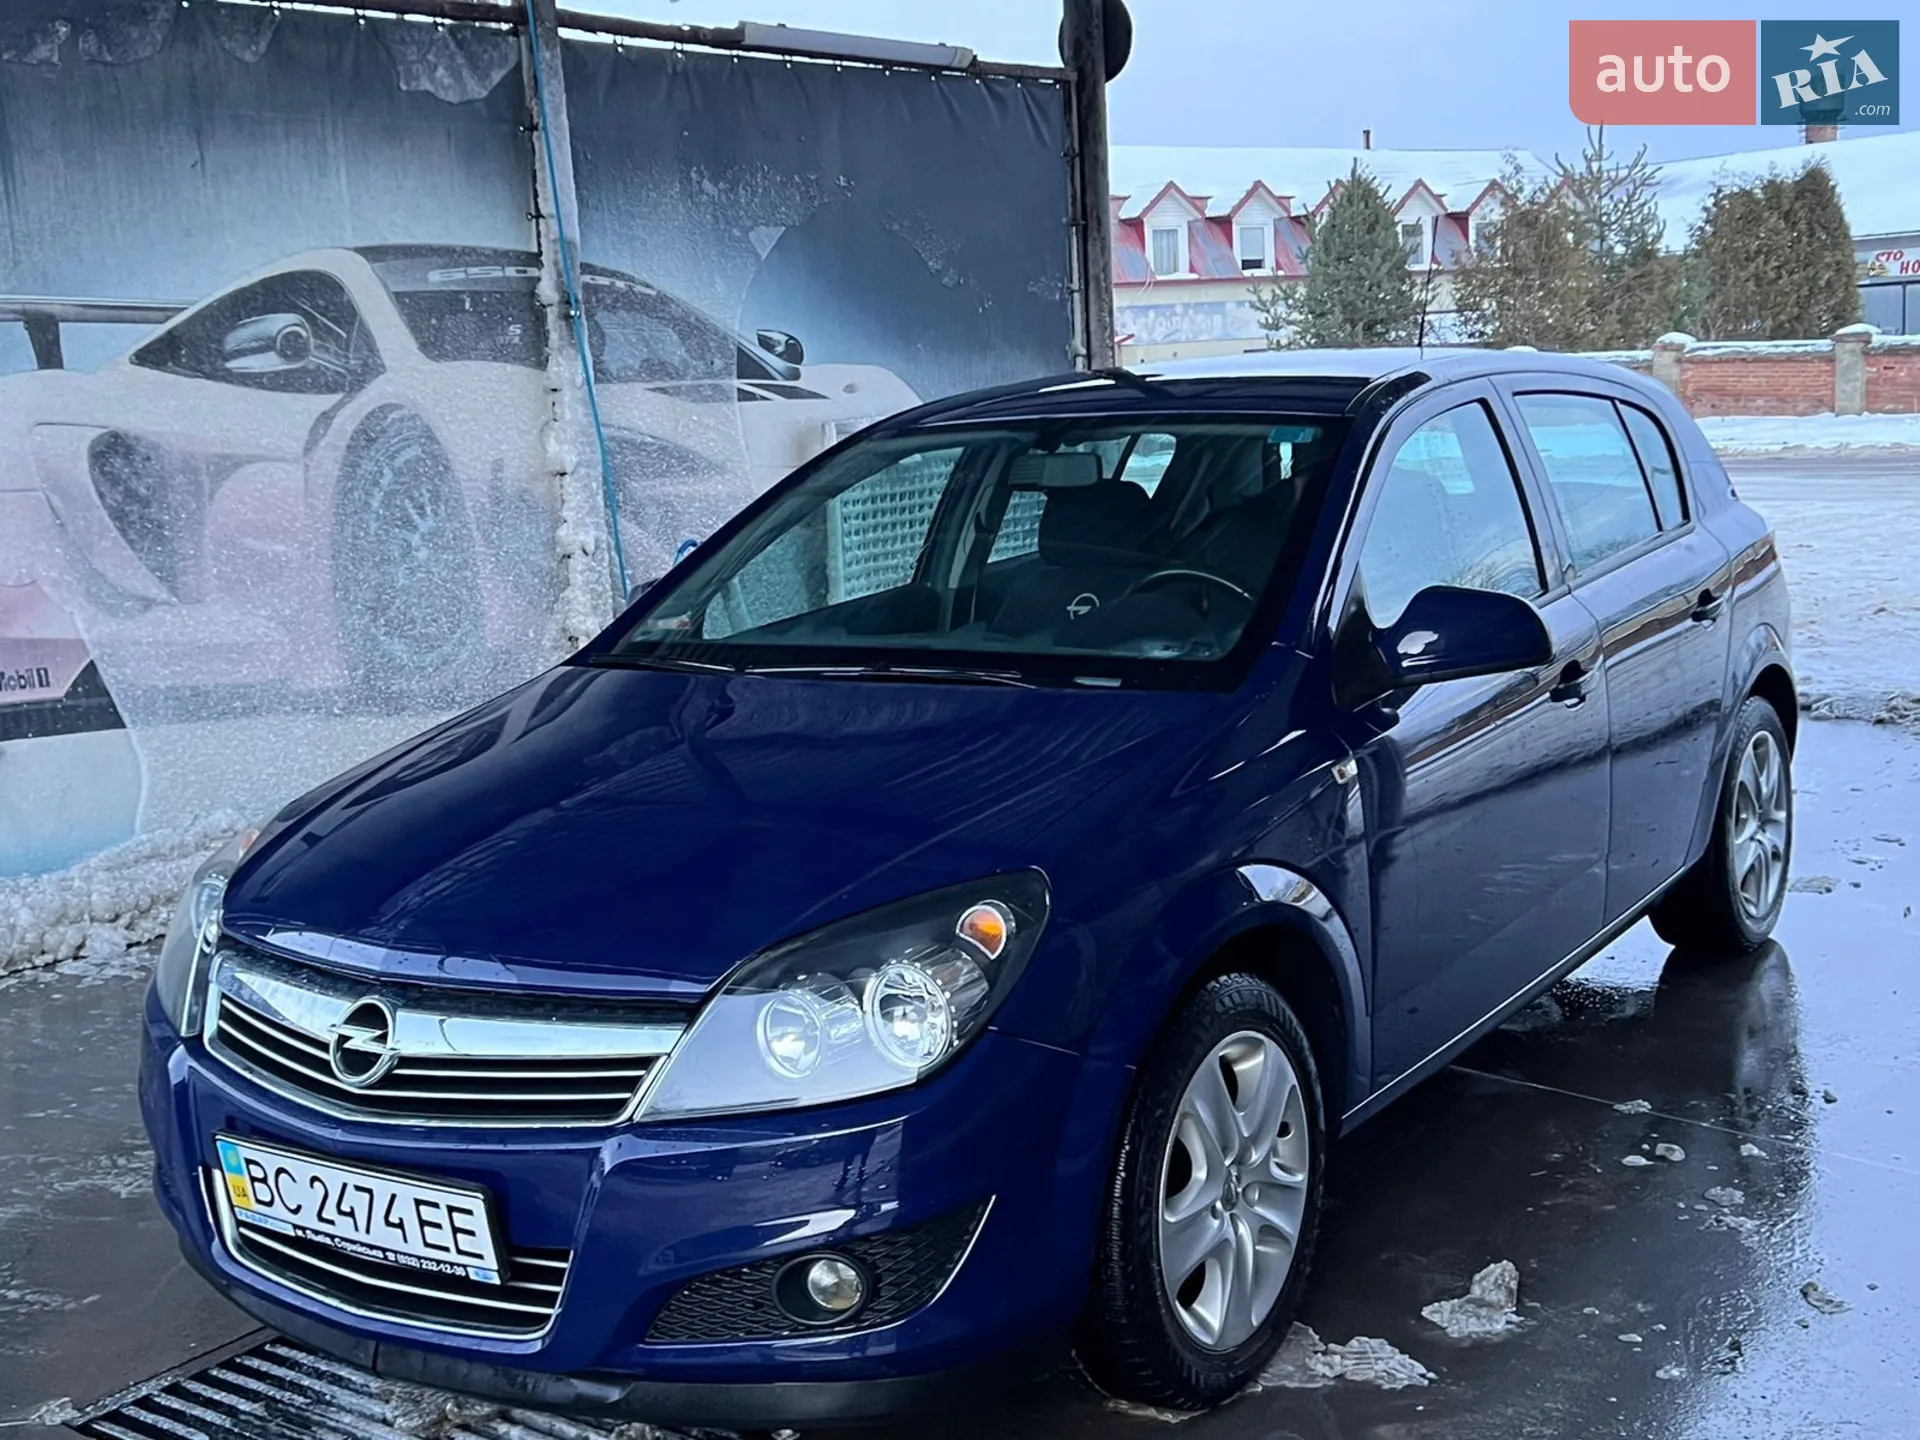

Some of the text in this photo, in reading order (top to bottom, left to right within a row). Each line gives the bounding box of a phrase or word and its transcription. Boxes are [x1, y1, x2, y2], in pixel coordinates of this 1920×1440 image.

[232, 1184, 248, 1198] UA
[243, 1157, 485, 1260] BC 2474 EE
